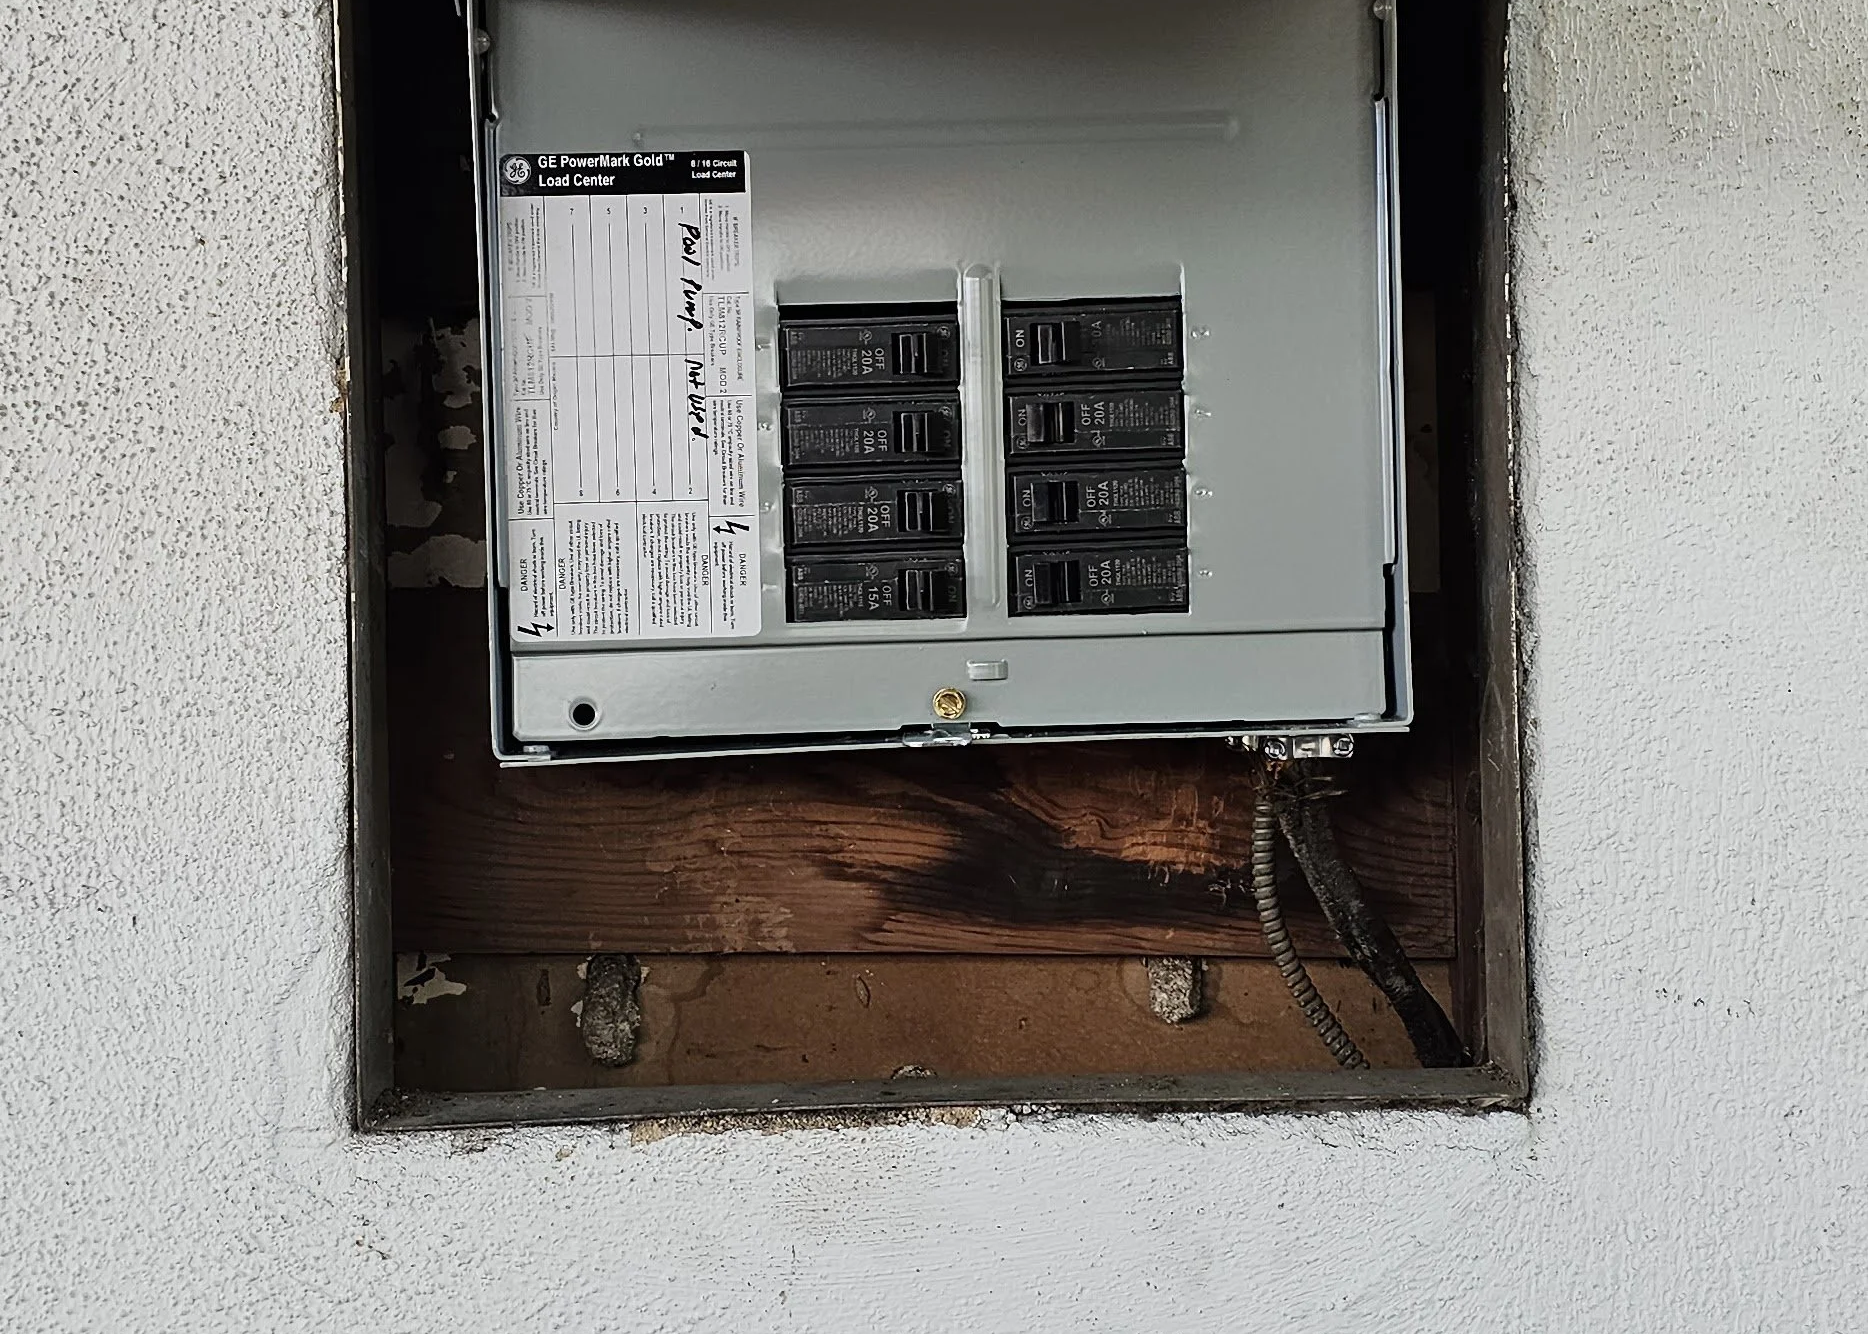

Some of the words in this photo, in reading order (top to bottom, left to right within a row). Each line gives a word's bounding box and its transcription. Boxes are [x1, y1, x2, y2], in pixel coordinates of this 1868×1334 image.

[538, 155, 557, 168] GE
[560, 154, 630, 167] PowerMark
[712, 159, 738, 167] Circuit
[539, 174, 570, 187] Load
[573, 173, 616, 186] Center
[691, 170, 711, 178] Load
[711, 170, 737, 178] Center
[607, 207, 611, 215] 5
[643, 206, 648, 214] 3
[678, 223, 702, 266] Pool
[1015, 329, 1025, 348] ON
[861, 350, 873, 375] 20A
[874, 348, 885, 370] OFF
[719, 367, 727, 387] MOD
[735, 399, 744, 414] Use
[1017, 408, 1027, 427] ON
[1081, 403, 1091, 426] OFF
[1093, 401, 1106, 425] 20A
[734, 415, 744, 441] Copper
[737, 442, 745, 451] Or
[863, 430, 875, 454] 20A
[877, 430, 888, 452] OFF
[516, 462, 524, 472] Or
[737, 453, 745, 490] Aluminum
[516, 473, 526, 499] Copper
[688, 487, 693, 495] 2
[1086, 486, 1096, 508] OFF
[1097, 480, 1110, 506] 20A
[517, 500, 525, 515] Use
[738, 491, 746, 508] Wire
[1022, 489, 1031, 508] ON
[867, 507, 879, 533] 20A
[880, 505, 891, 528] OFF
[520, 558, 528, 592] DANGER
[558, 557, 566, 590] DANGER
[701, 554, 709, 587] DANGER
[739, 553, 747, 587] DANGER
[1024, 569, 1033, 587] ON
[1088, 565, 1099, 587] OFF
[1100, 560, 1112, 585] 20A
[868, 586, 880, 611] 15A
[882, 585, 893, 607] OFF
